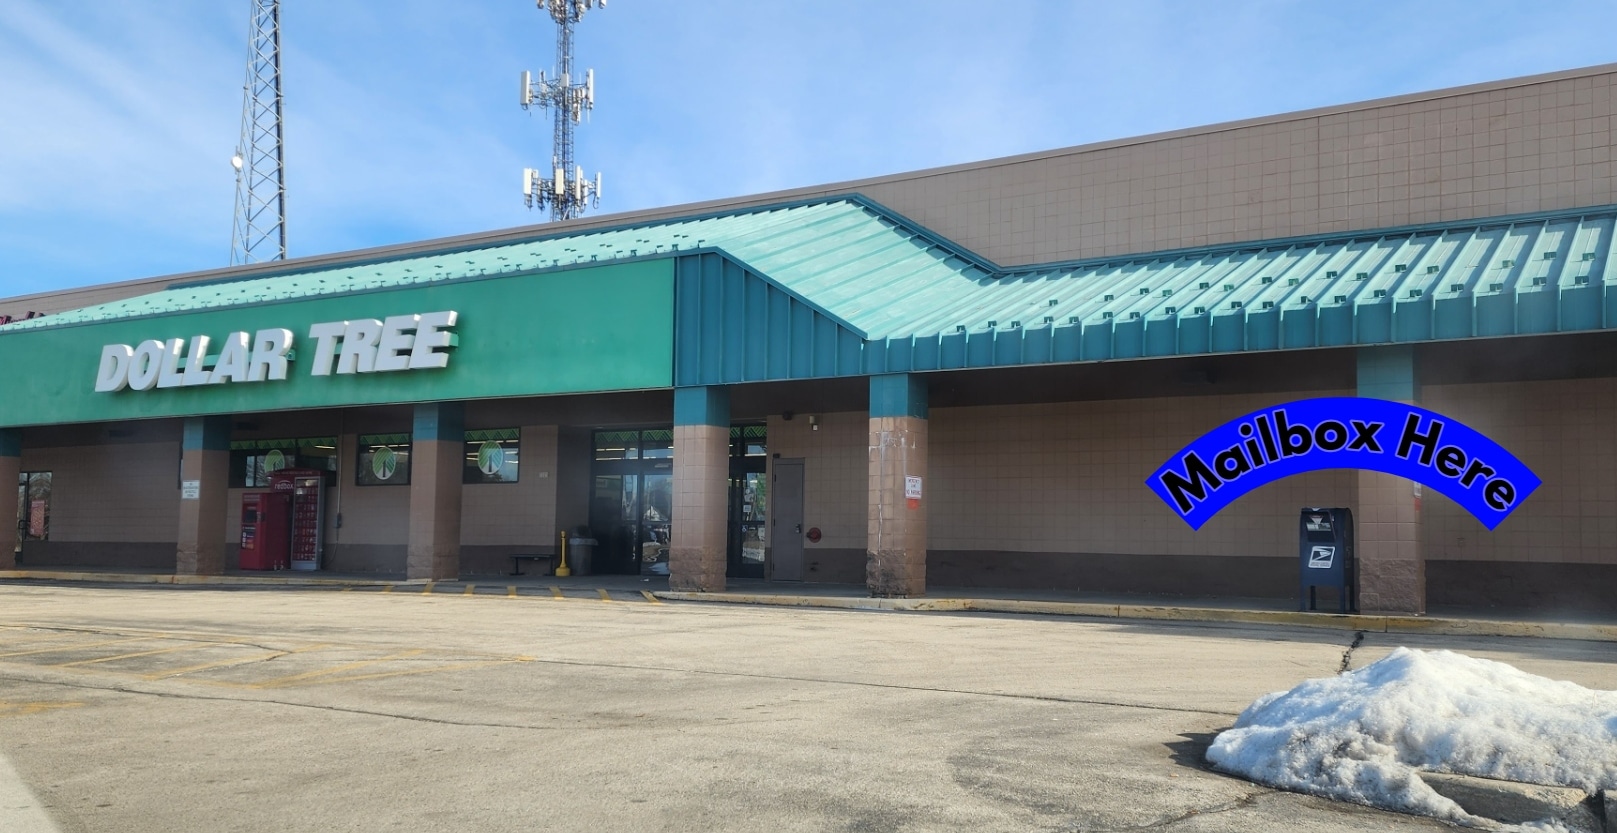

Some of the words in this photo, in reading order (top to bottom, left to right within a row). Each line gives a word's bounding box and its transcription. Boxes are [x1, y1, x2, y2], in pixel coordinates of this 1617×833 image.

[95, 328, 294, 392] DOLLAR
[309, 311, 458, 376] TREE
[274, 481, 294, 490] redbox
